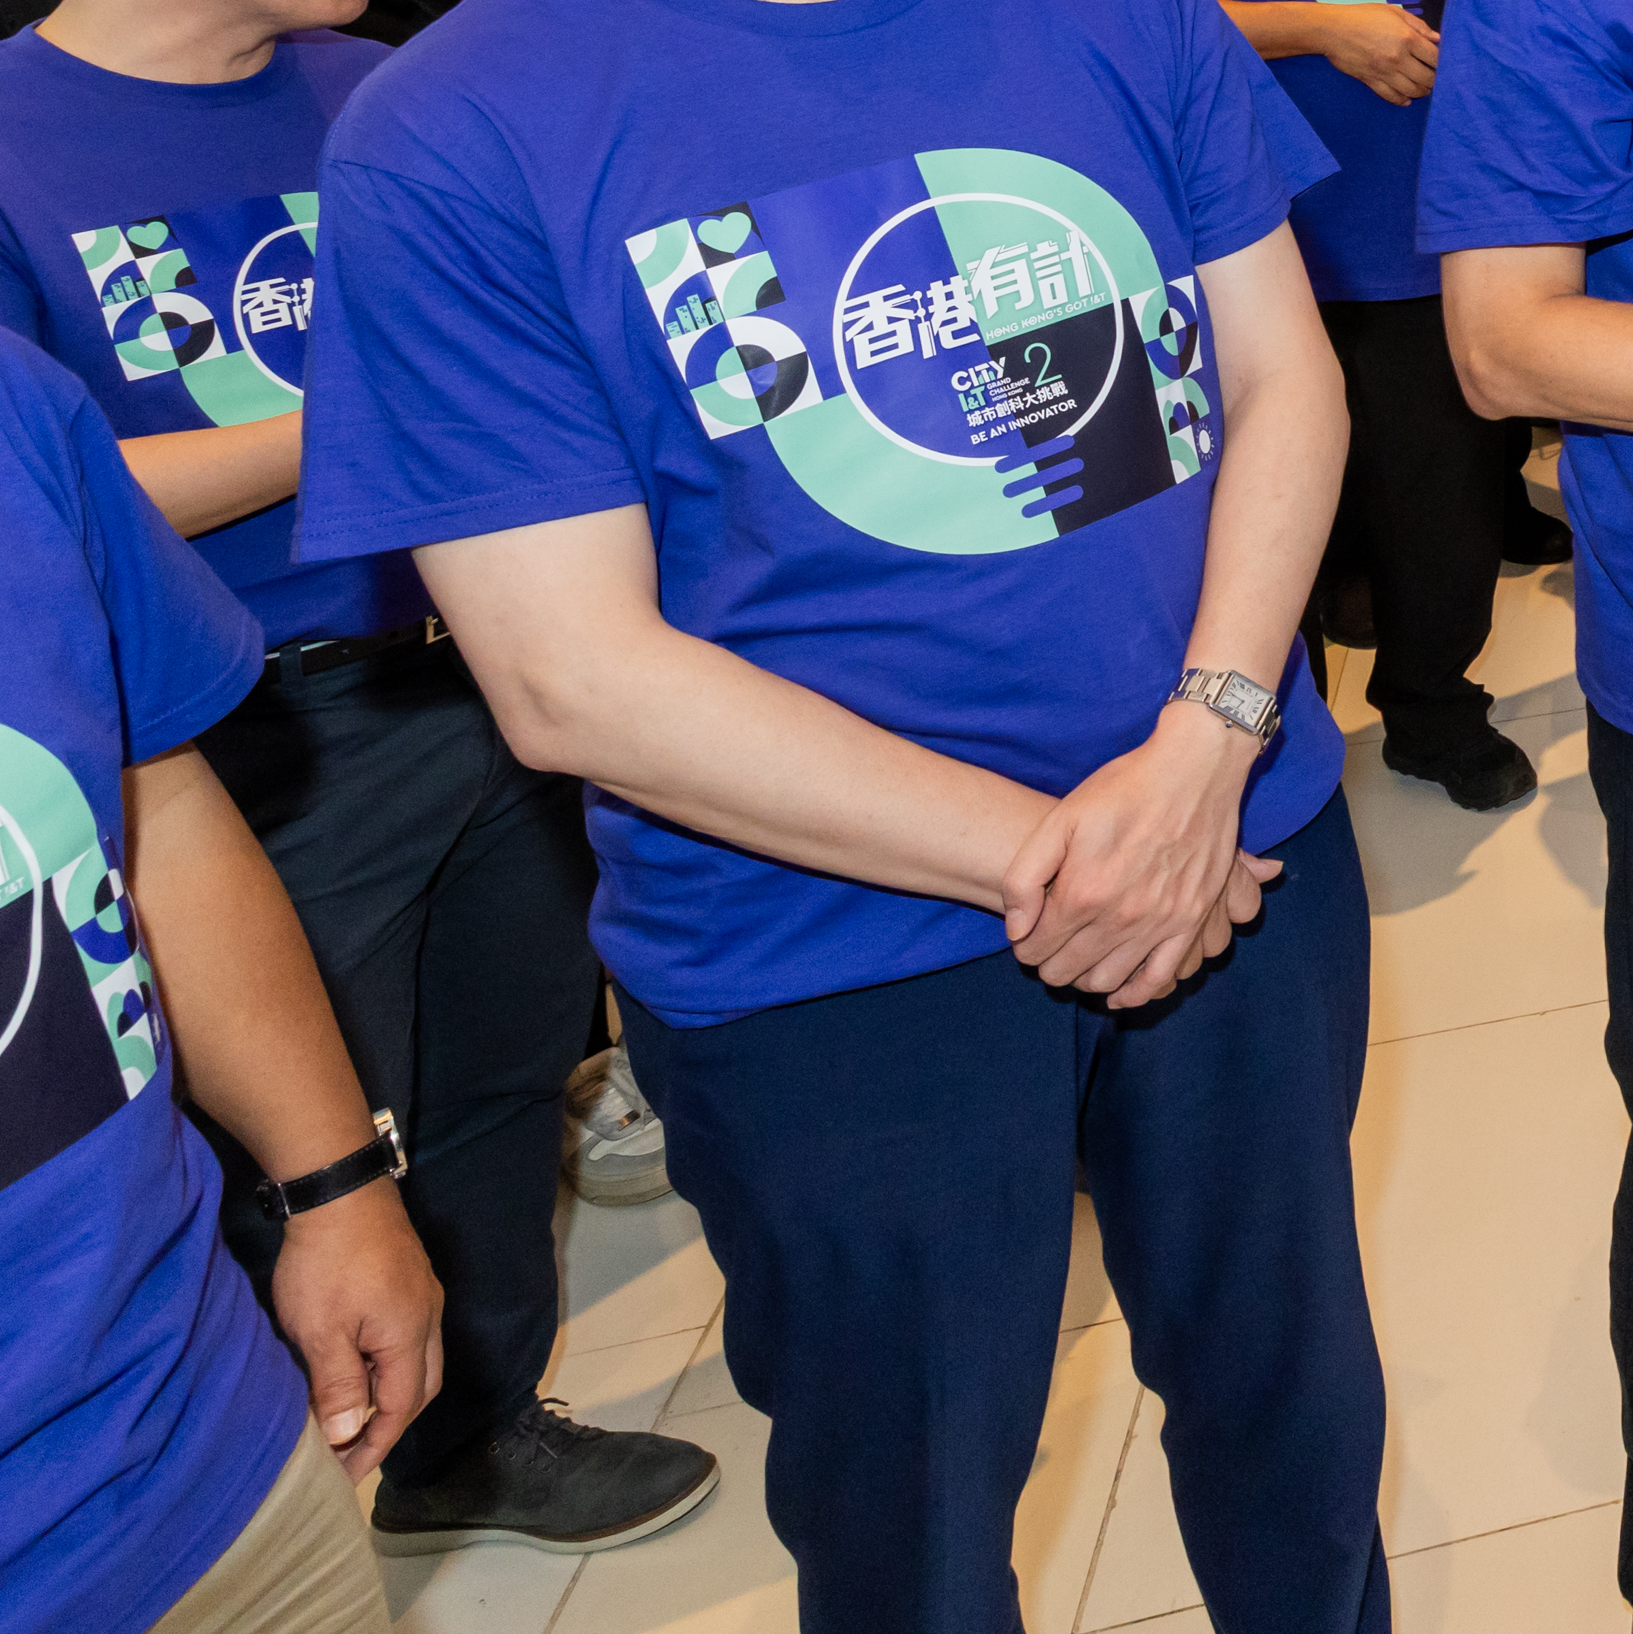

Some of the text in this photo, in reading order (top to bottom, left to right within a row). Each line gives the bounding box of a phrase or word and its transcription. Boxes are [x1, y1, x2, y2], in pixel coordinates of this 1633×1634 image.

[843, 231, 1095, 370] 香港有計
[986, 292, 1106, 341] HONG KONG'S GOT I&T
[951, 357, 1006, 392] CITY
[986, 377, 1011, 390] GRAND
[989, 377, 1030, 397] CHALLENGE
[1024, 342, 1062, 388] 2
[958, 385, 987, 413] I&T
[967, 381, 1068, 428] 城市創科大挑戰
[970, 399, 1077, 445] BE AN INNOVATOR
